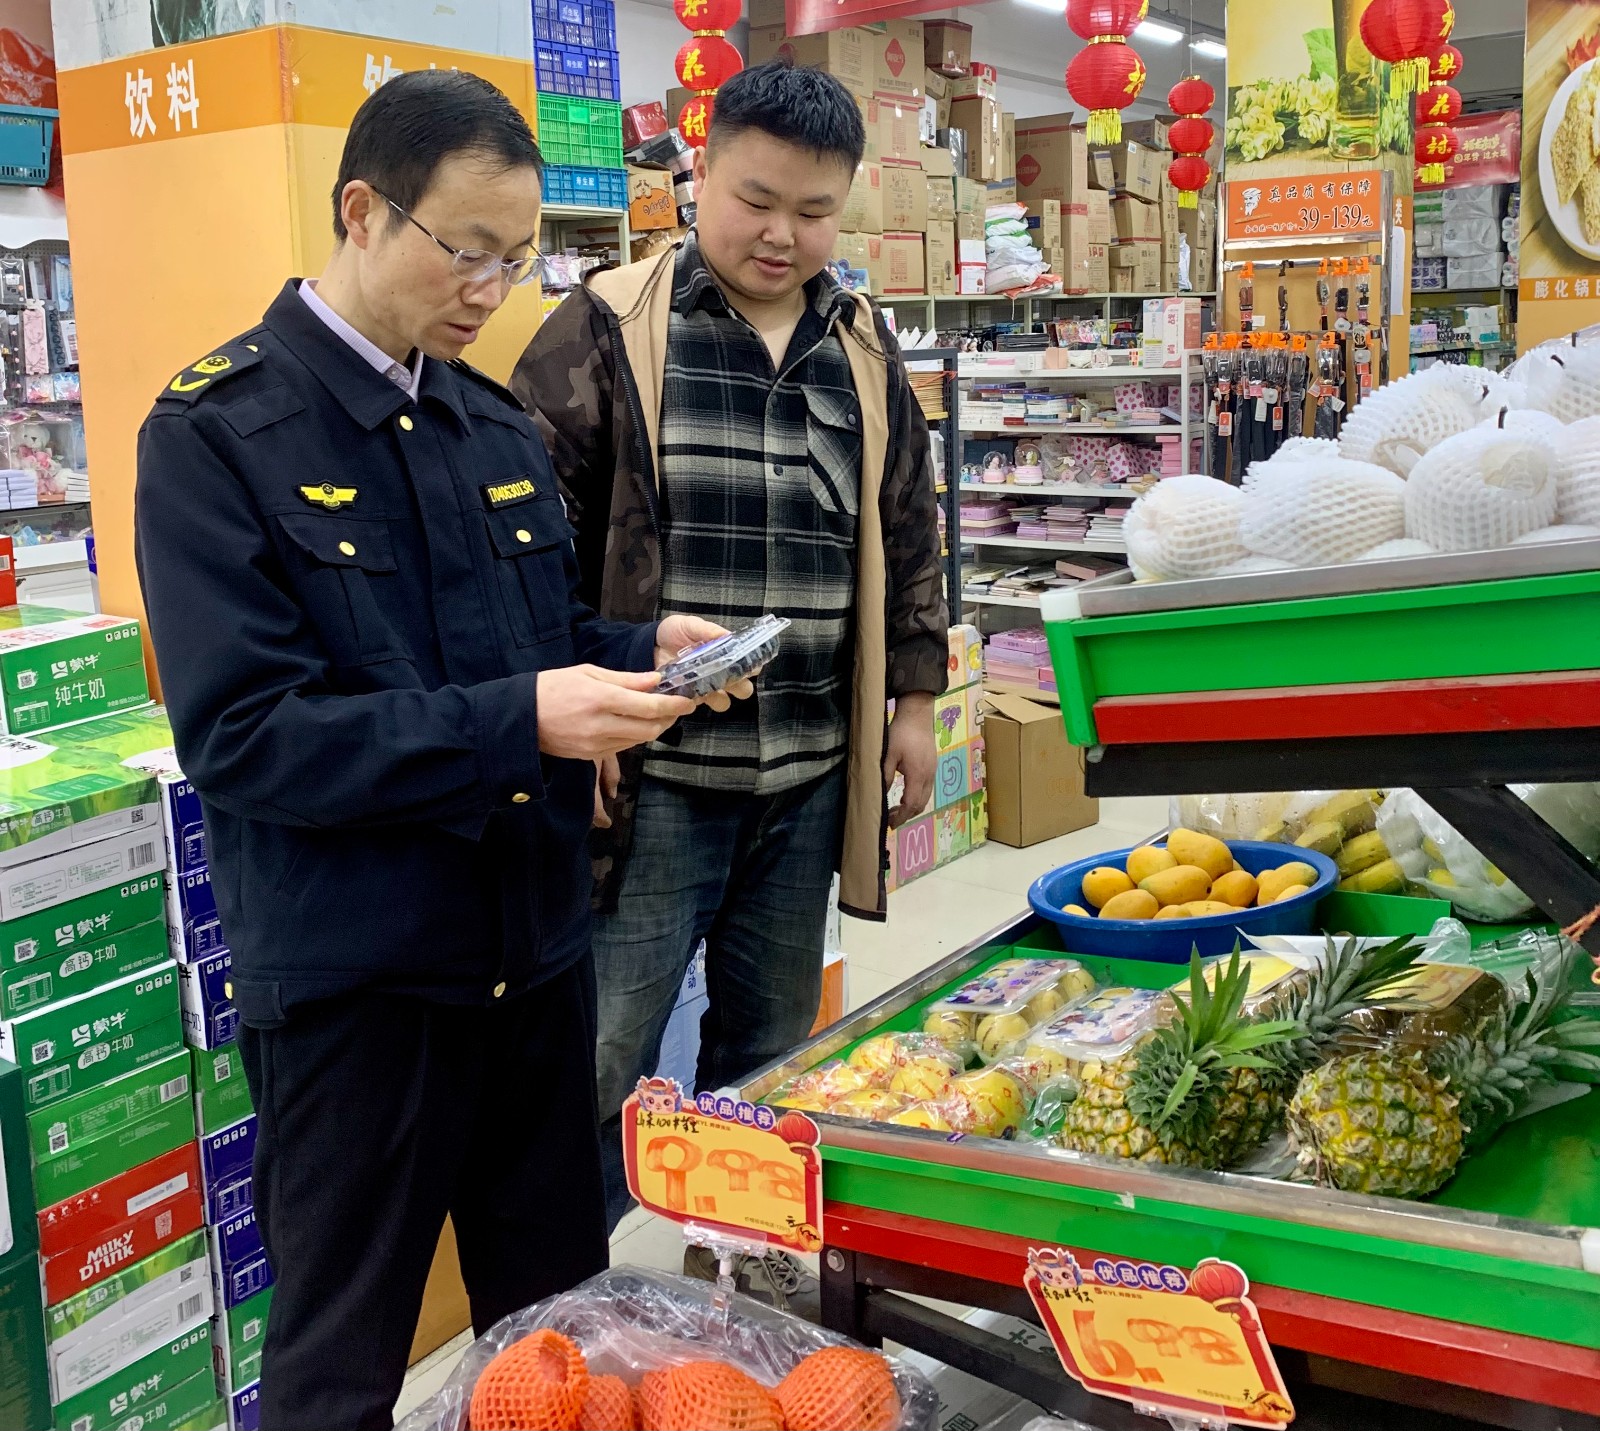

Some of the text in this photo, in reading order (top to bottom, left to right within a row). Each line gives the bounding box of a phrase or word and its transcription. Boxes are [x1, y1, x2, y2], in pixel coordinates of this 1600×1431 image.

[124, 58, 200, 138] 饮料
[1268, 178, 1371, 203] 真品质有保障
[69, 654, 99, 673] 蒙牛
[55, 678, 106, 708] 纯牛奶
[77, 914, 111, 938] 蒙牛
[93, 1012, 126, 1038] 蒙牛
[699, 1096, 771, 1127] 优品推荐
[86, 1229, 134, 1265] Milky
[79, 1244, 135, 1281] Drink
[1097, 1264, 1184, 1290] 优品推荐
[130, 1373, 163, 1403] 蒙牛
